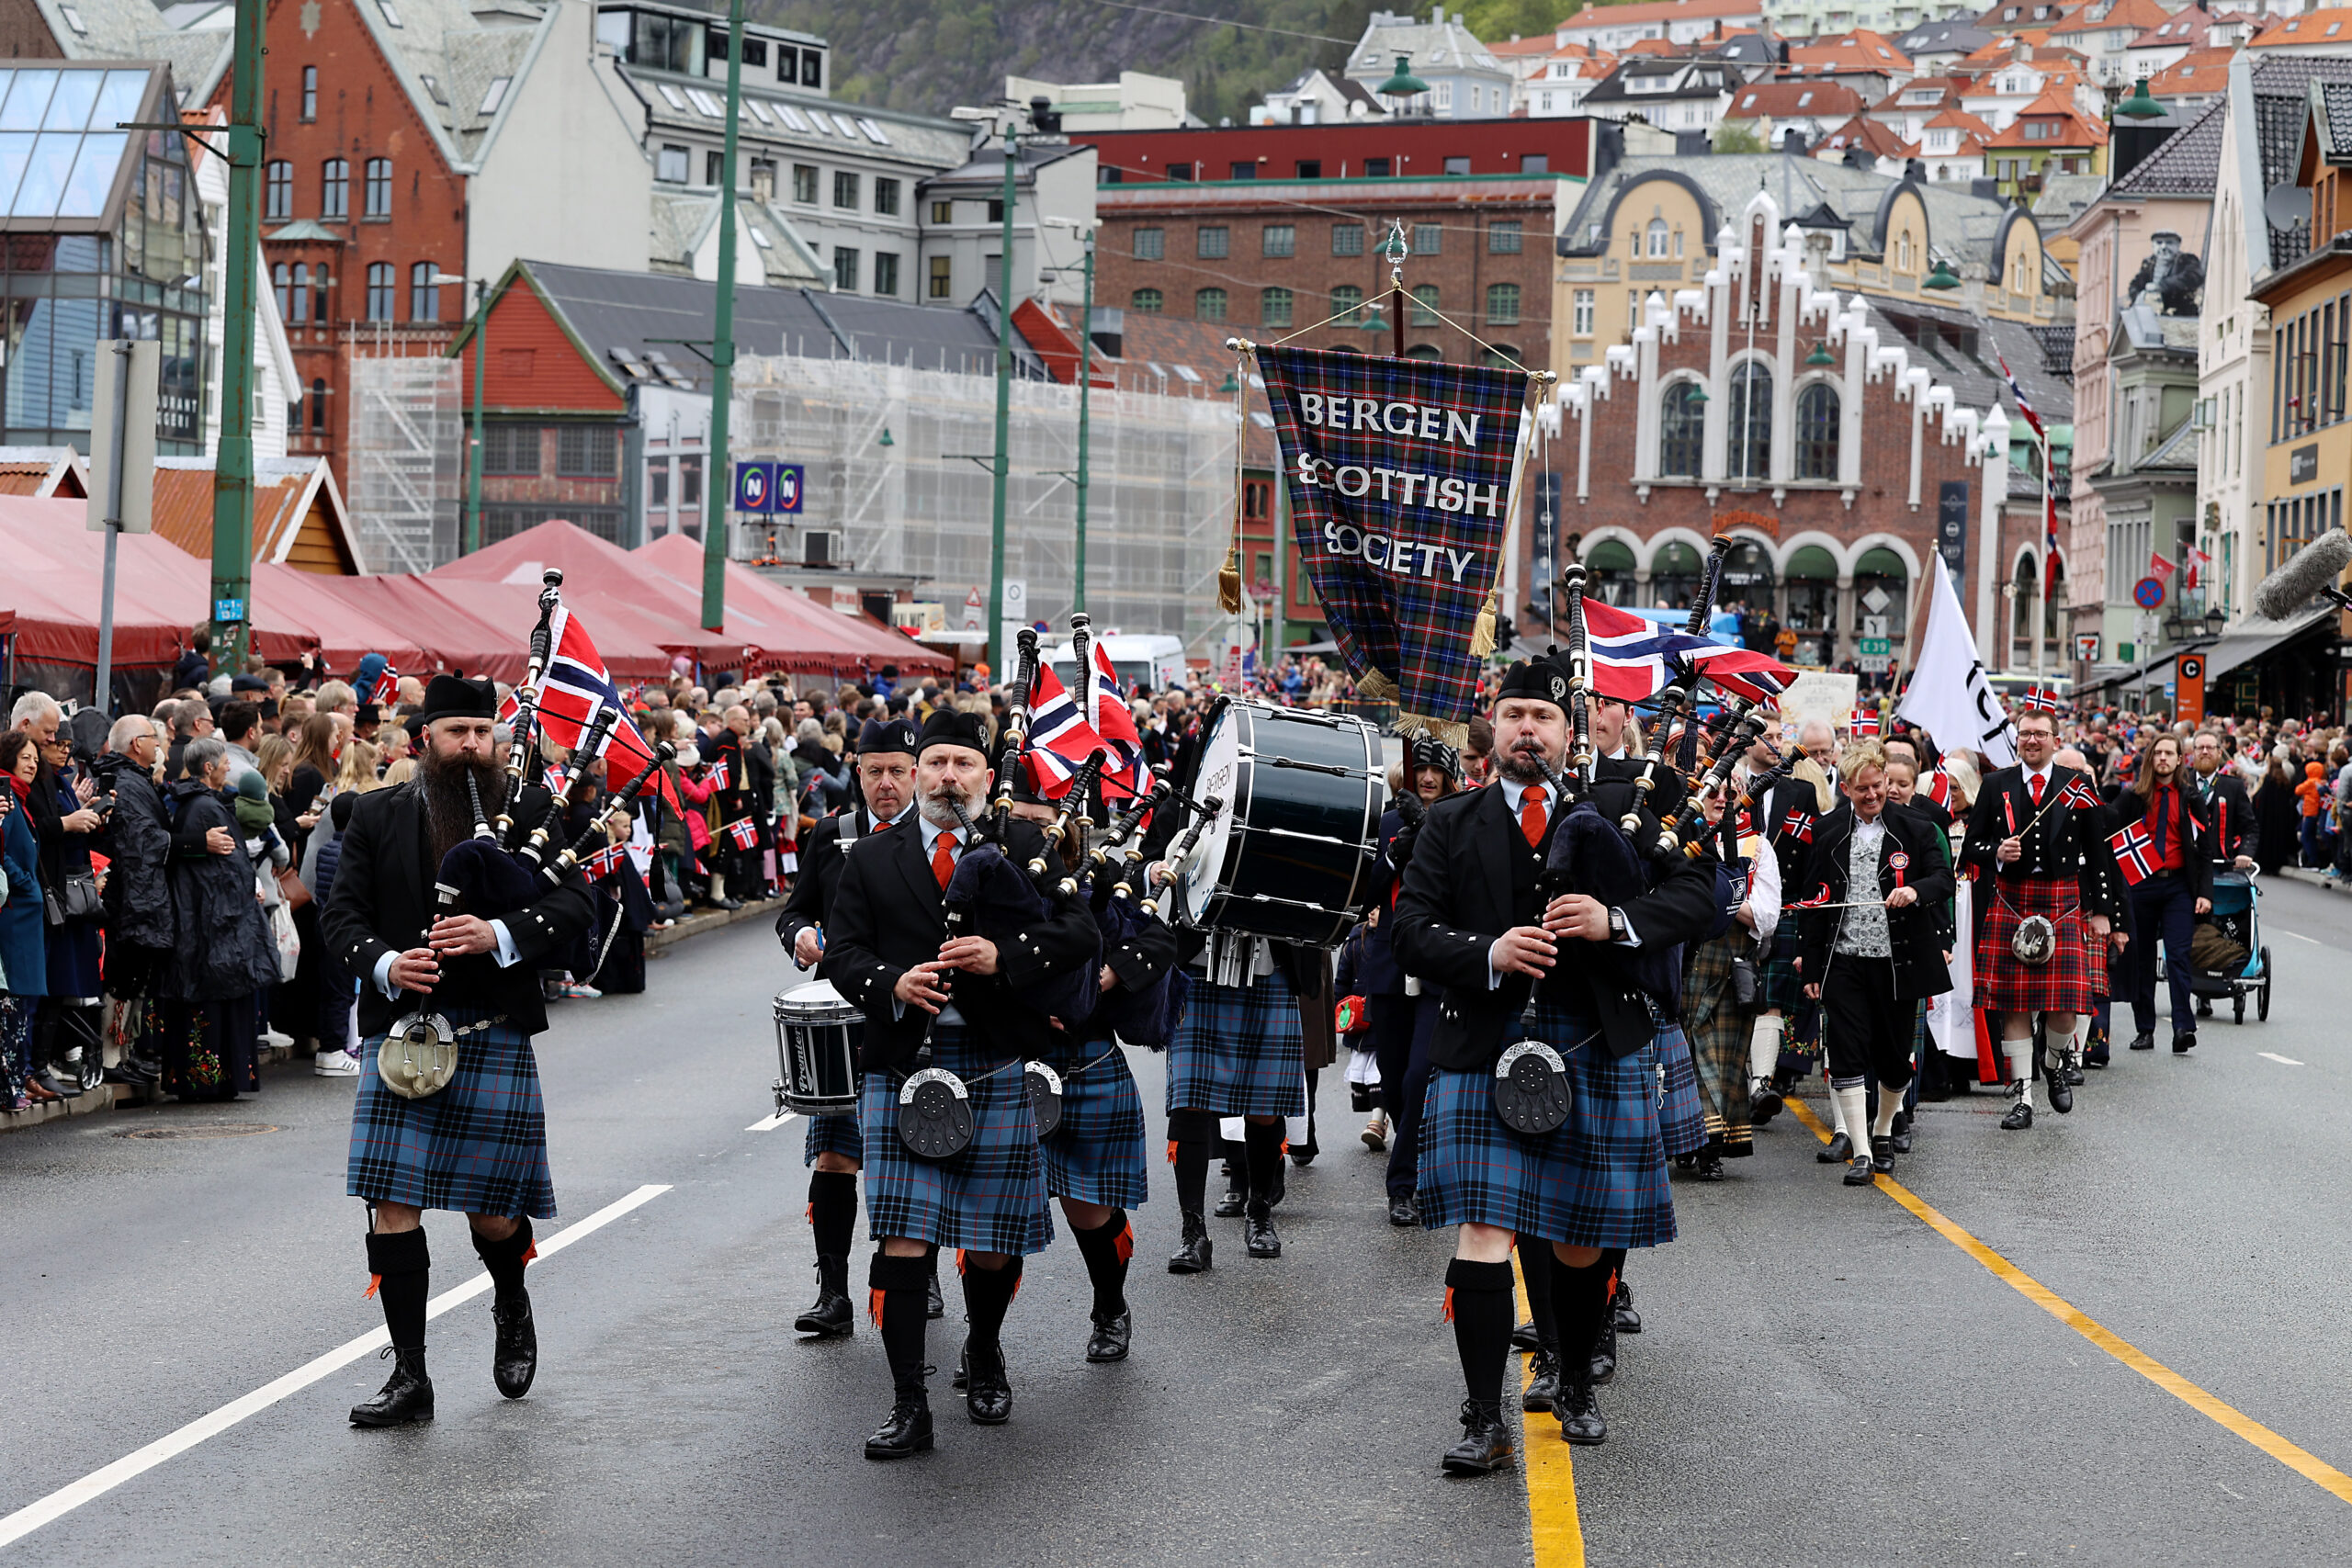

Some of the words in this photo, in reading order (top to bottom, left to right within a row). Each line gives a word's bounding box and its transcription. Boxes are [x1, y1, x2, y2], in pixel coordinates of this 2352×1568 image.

[1299, 392, 1481, 447] BERGEN
[747, 479, 762, 496] N
[783, 479, 794, 498] N
[1296, 452, 1499, 517] SCOTTISH
[1324, 520, 1476, 582] SOCIETY
[1862, 641, 1870, 652] E
[1871, 642, 1887, 652] 39
[1864, 660, 1884, 669] 585
[2186, 662, 2197, 676] C
[795, 1027, 808, 1092] Premier
